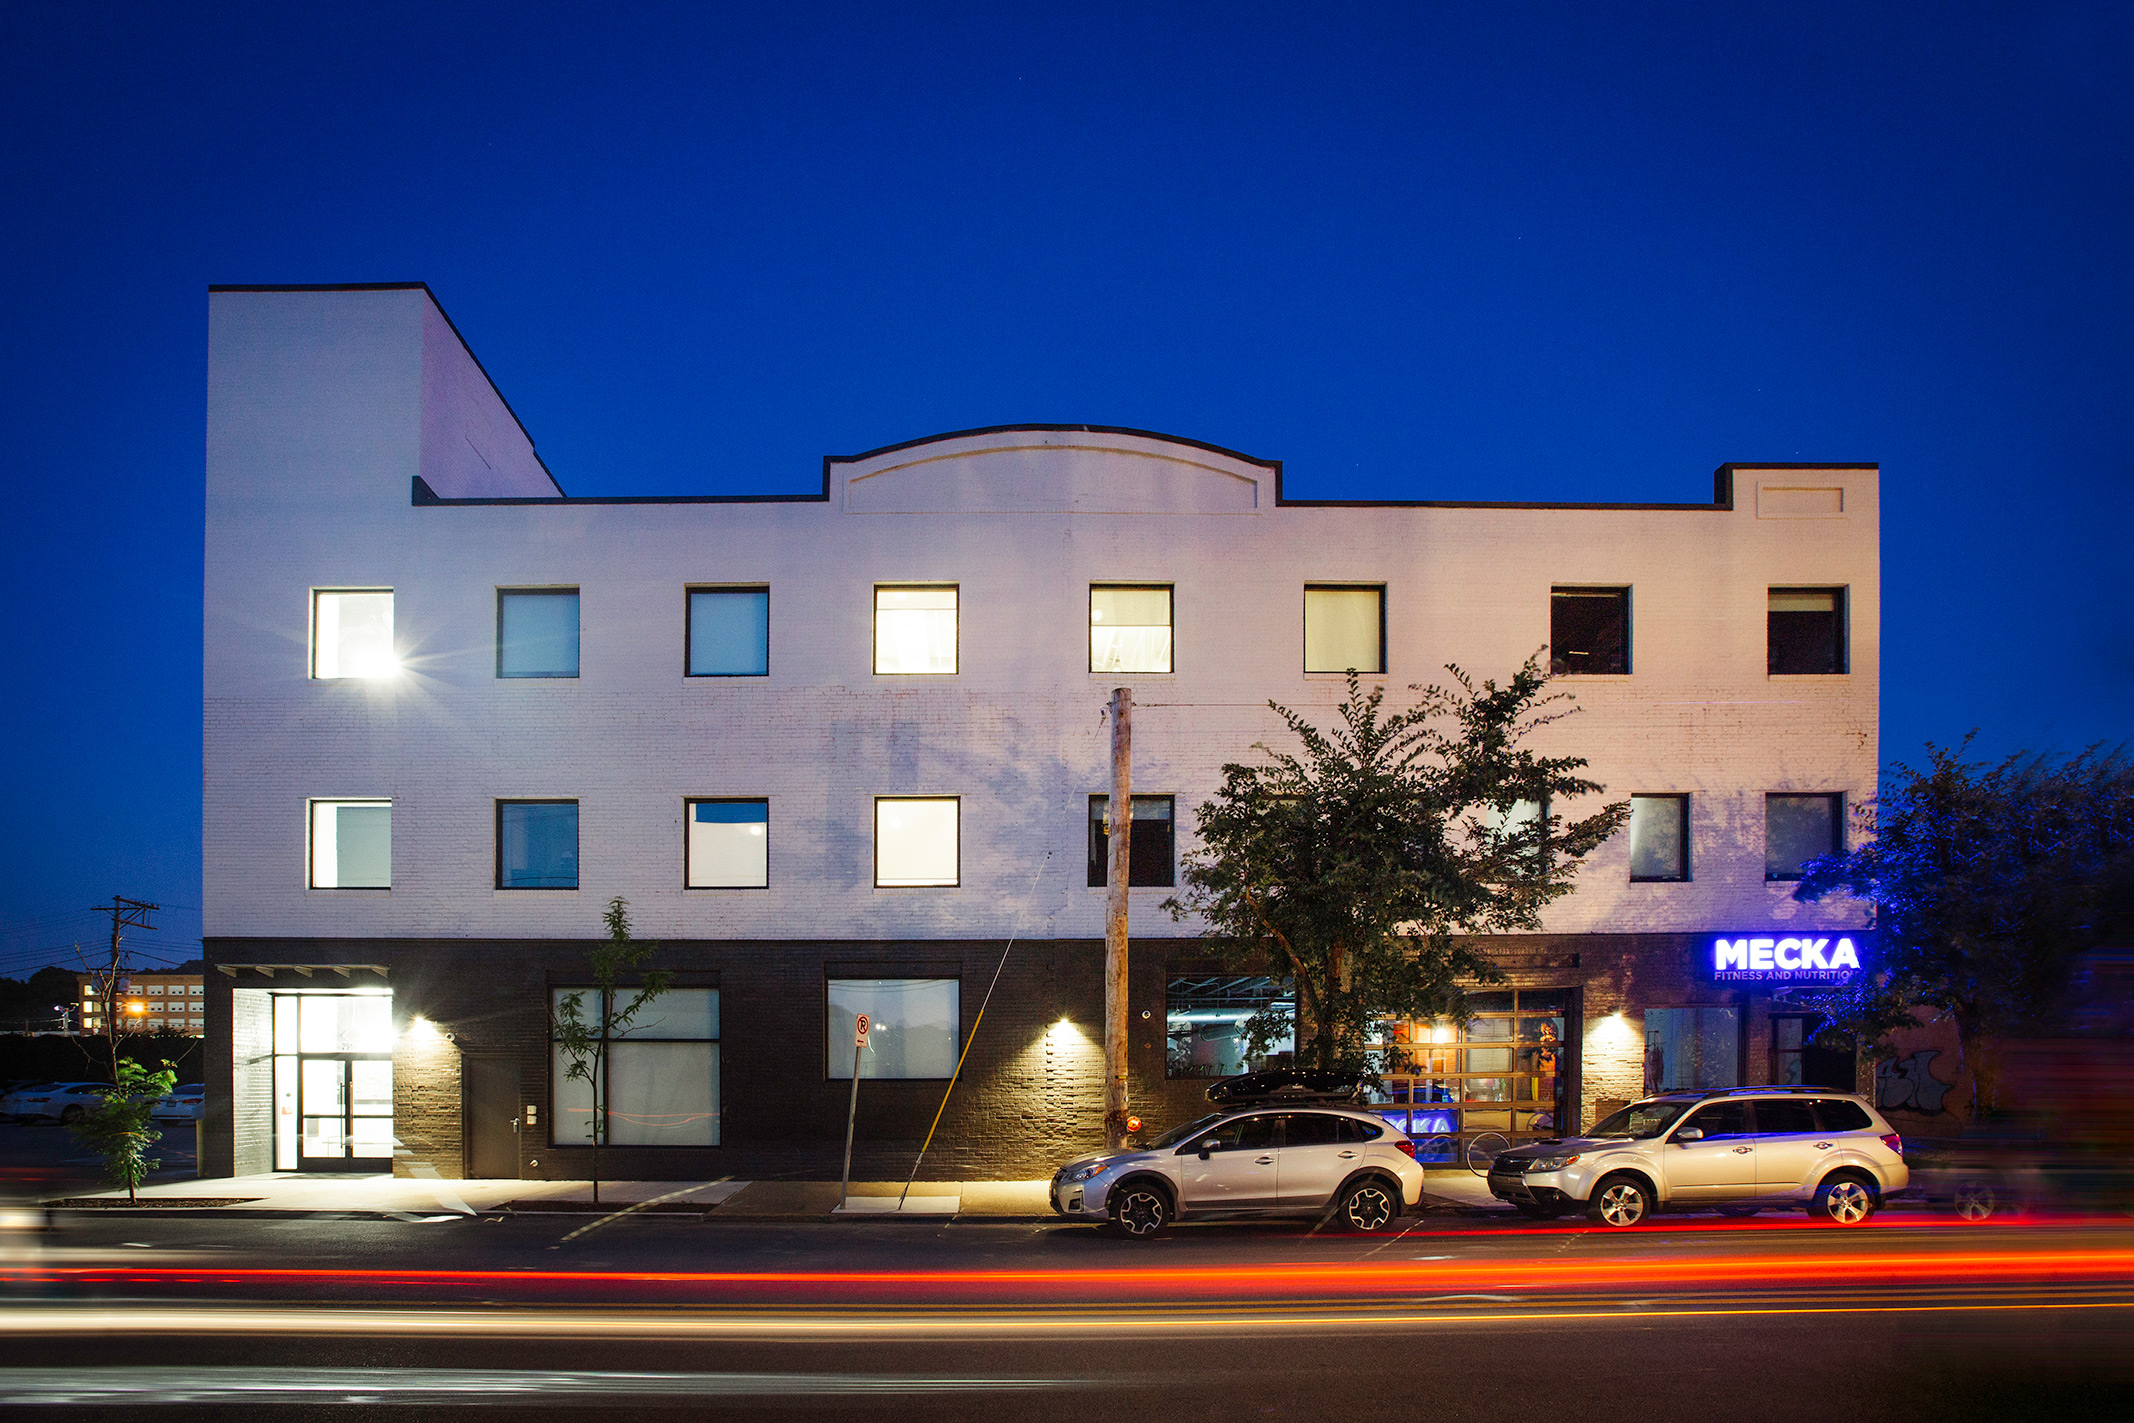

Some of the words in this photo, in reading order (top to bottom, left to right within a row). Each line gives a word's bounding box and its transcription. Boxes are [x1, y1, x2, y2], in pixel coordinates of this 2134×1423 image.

[1716, 938, 1860, 970] MECKA
[1715, 970, 1763, 980] FITNESS
[1766, 970, 1791, 980] AND
[1794, 970, 1859, 980] NUTRITIO
